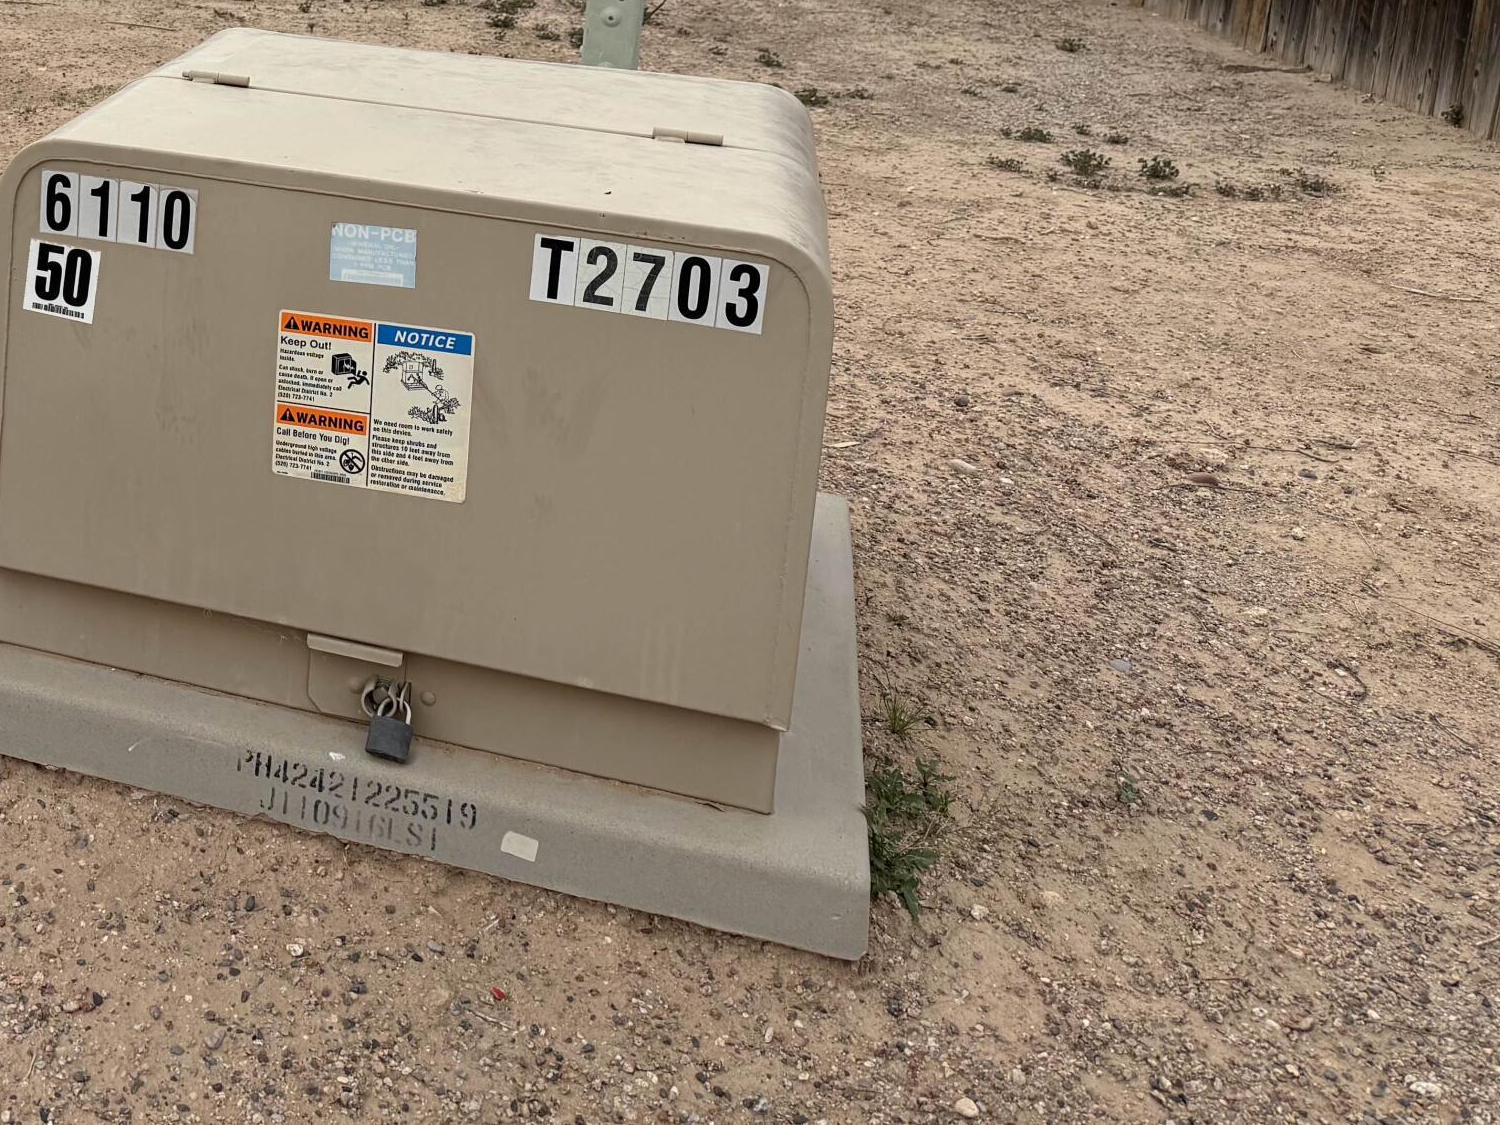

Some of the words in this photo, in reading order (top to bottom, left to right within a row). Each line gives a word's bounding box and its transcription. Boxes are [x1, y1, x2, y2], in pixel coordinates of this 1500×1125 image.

[45, 173, 191, 251] 6110
[35, 242, 92, 307] 50
[540, 237, 761, 328] T2703
[301, 320, 368, 339] WARNING
[280, 336, 306, 348] Keep
[310, 340, 332, 350] Out!
[394, 330, 457, 350] NOTICE
[296, 412, 364, 432] WARNING
[277, 427, 290, 436] Call
[293, 429, 317, 440] Before
[319, 433, 332, 442] You
[335, 435, 350, 446] Dig!
[372, 434, 391, 442] Please
[392, 437, 405, 445] keep
[393, 428, 412, 436] device.
[436, 428, 452, 436] safely
[276, 440, 306, 449] Underground
[372, 442, 399, 451] structures
[437, 450, 450, 458] from
[440, 458, 453, 466] from
[371, 465, 405, 475] Obstructions
[428, 473, 454, 483] damaged
[403, 476, 420, 485] during
[422, 479, 442, 487] service
[371, 479, 400, 488] restoration
